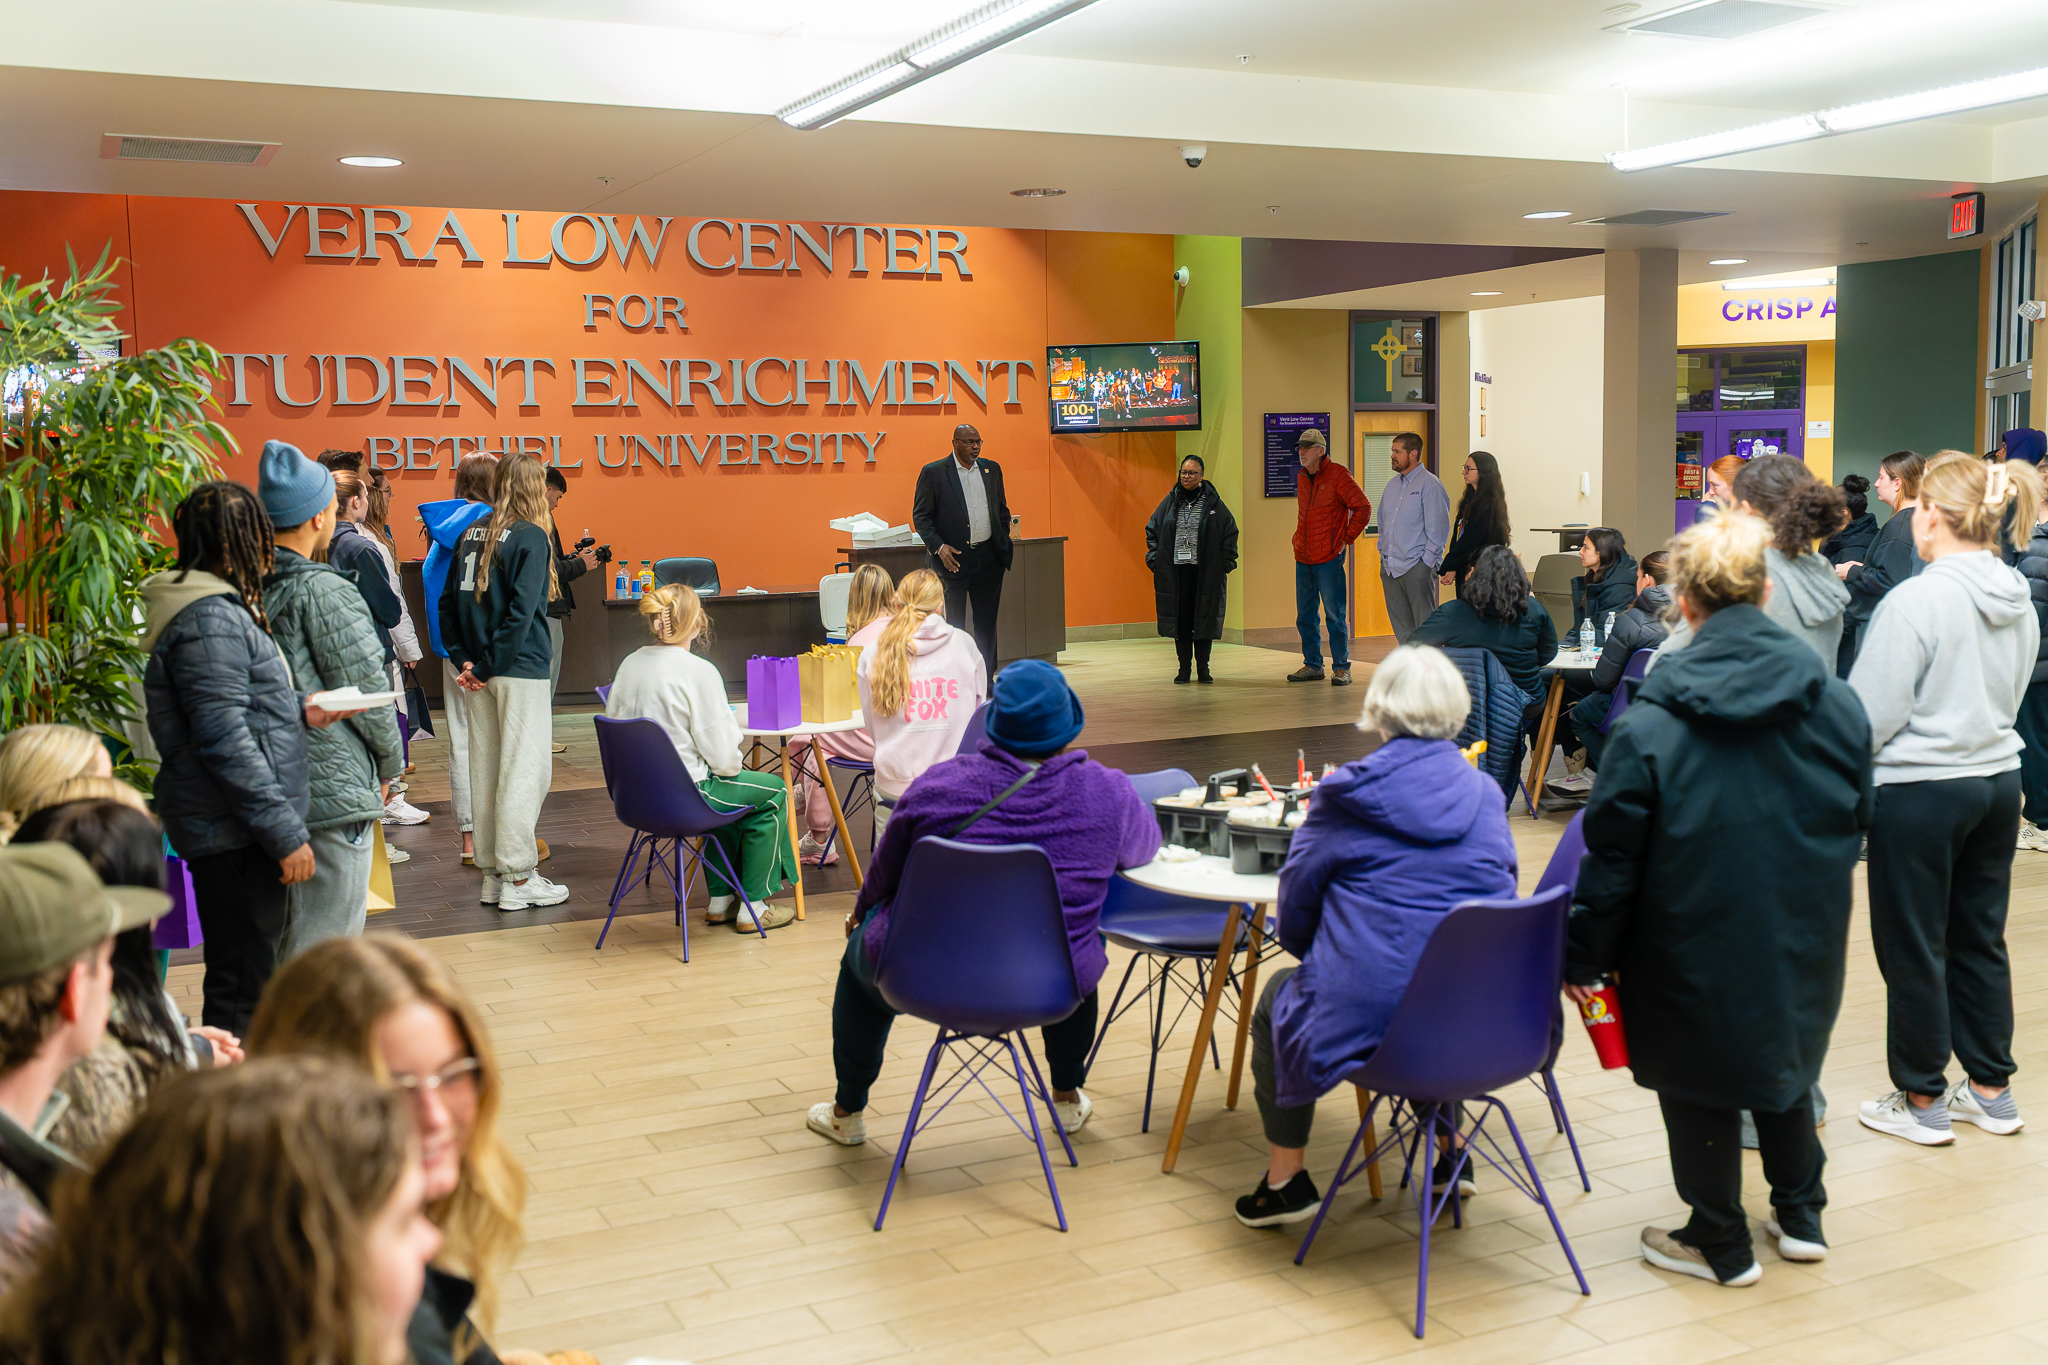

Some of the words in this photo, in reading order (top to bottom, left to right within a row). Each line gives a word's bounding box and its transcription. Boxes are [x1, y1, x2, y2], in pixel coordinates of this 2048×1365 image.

[1952, 199, 1974, 233] EXIT
[236, 203, 484, 263] VERA
[502, 213, 674, 267] LOW
[687, 219, 973, 275] CENTER
[583, 293, 689, 329] FOR
[1722, 297, 1813, 321] CRISP
[571, 357, 1035, 408] ENRICHMENT
[1061, 403, 1095, 416] 100+
[366, 435, 582, 471] BETHEL
[594, 431, 886, 468] UNIVERSITY
[903, 677, 958, 699] HITE
[904, 697, 948, 722] FOX
